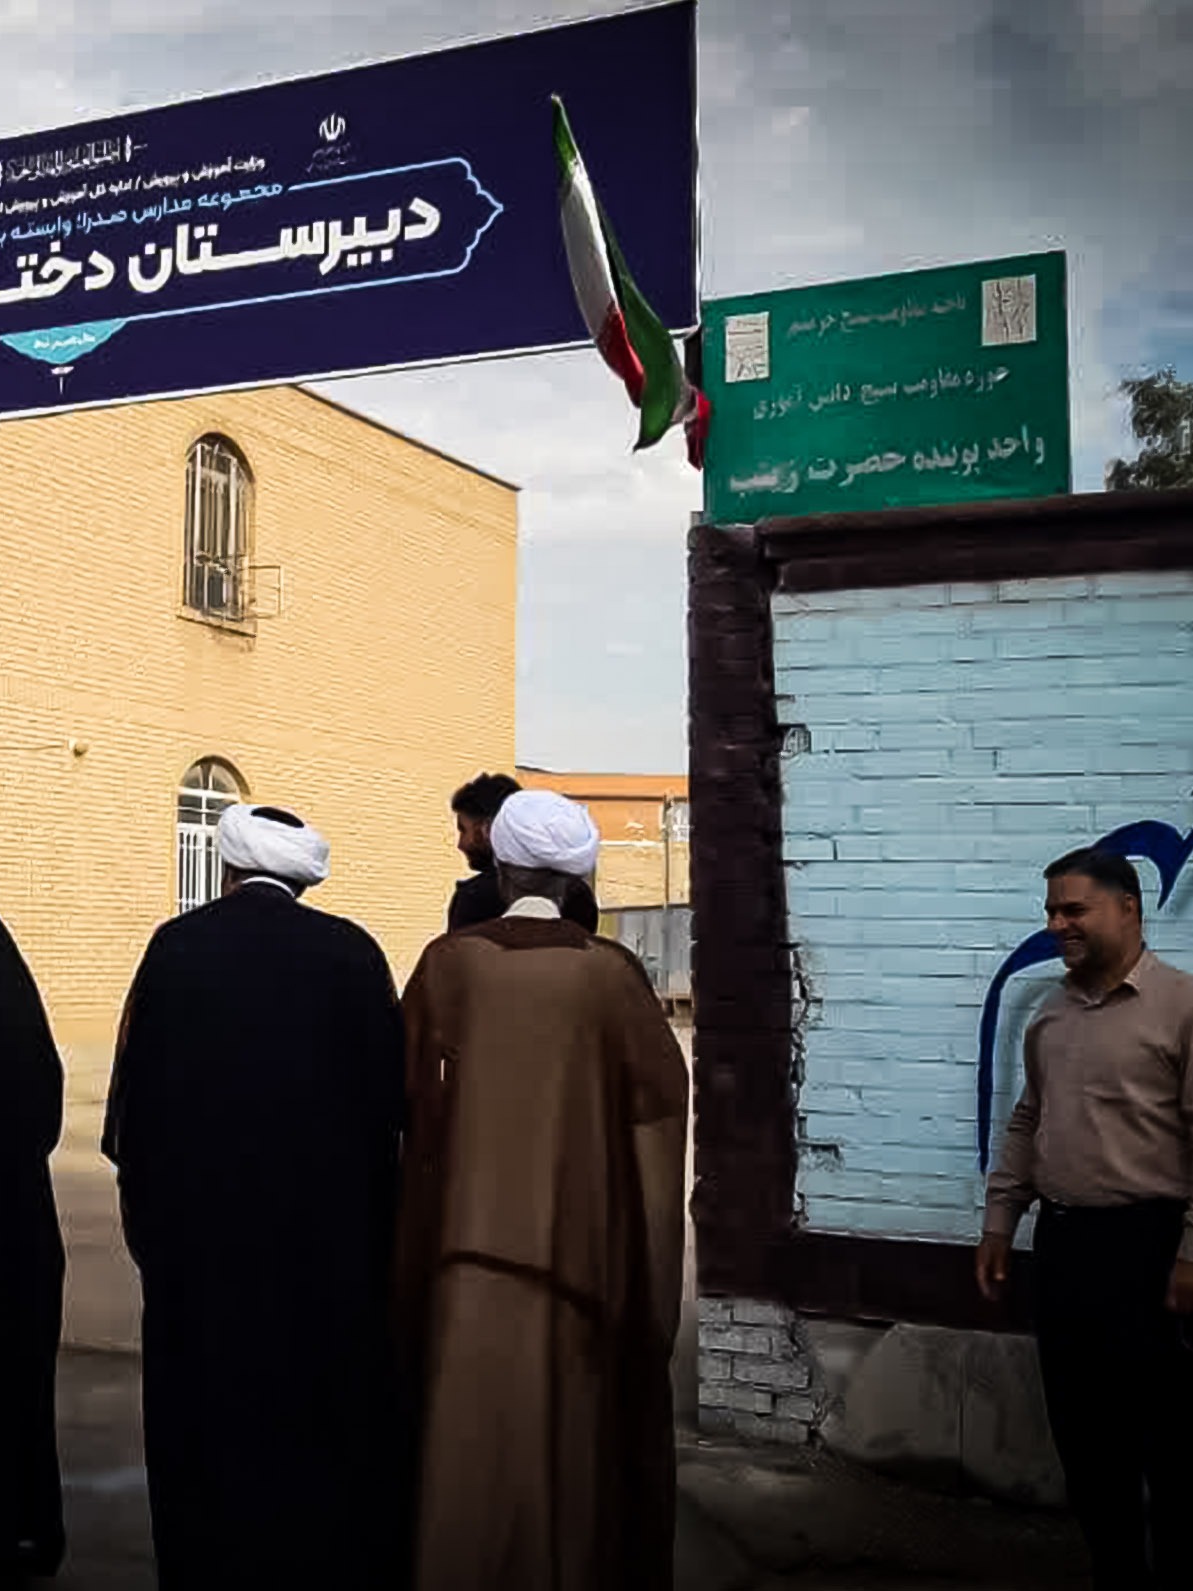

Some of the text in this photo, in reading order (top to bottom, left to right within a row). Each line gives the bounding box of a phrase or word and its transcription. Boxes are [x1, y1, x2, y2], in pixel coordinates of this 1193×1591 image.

[132, 196, 192, 224] مدارس
[196, 182, 283, 211] مجموعه
[10, 216, 72, 241] وابسته
[128, 196, 441, 293] دبیرستان
[987, 424, 1045, 465] واحد
